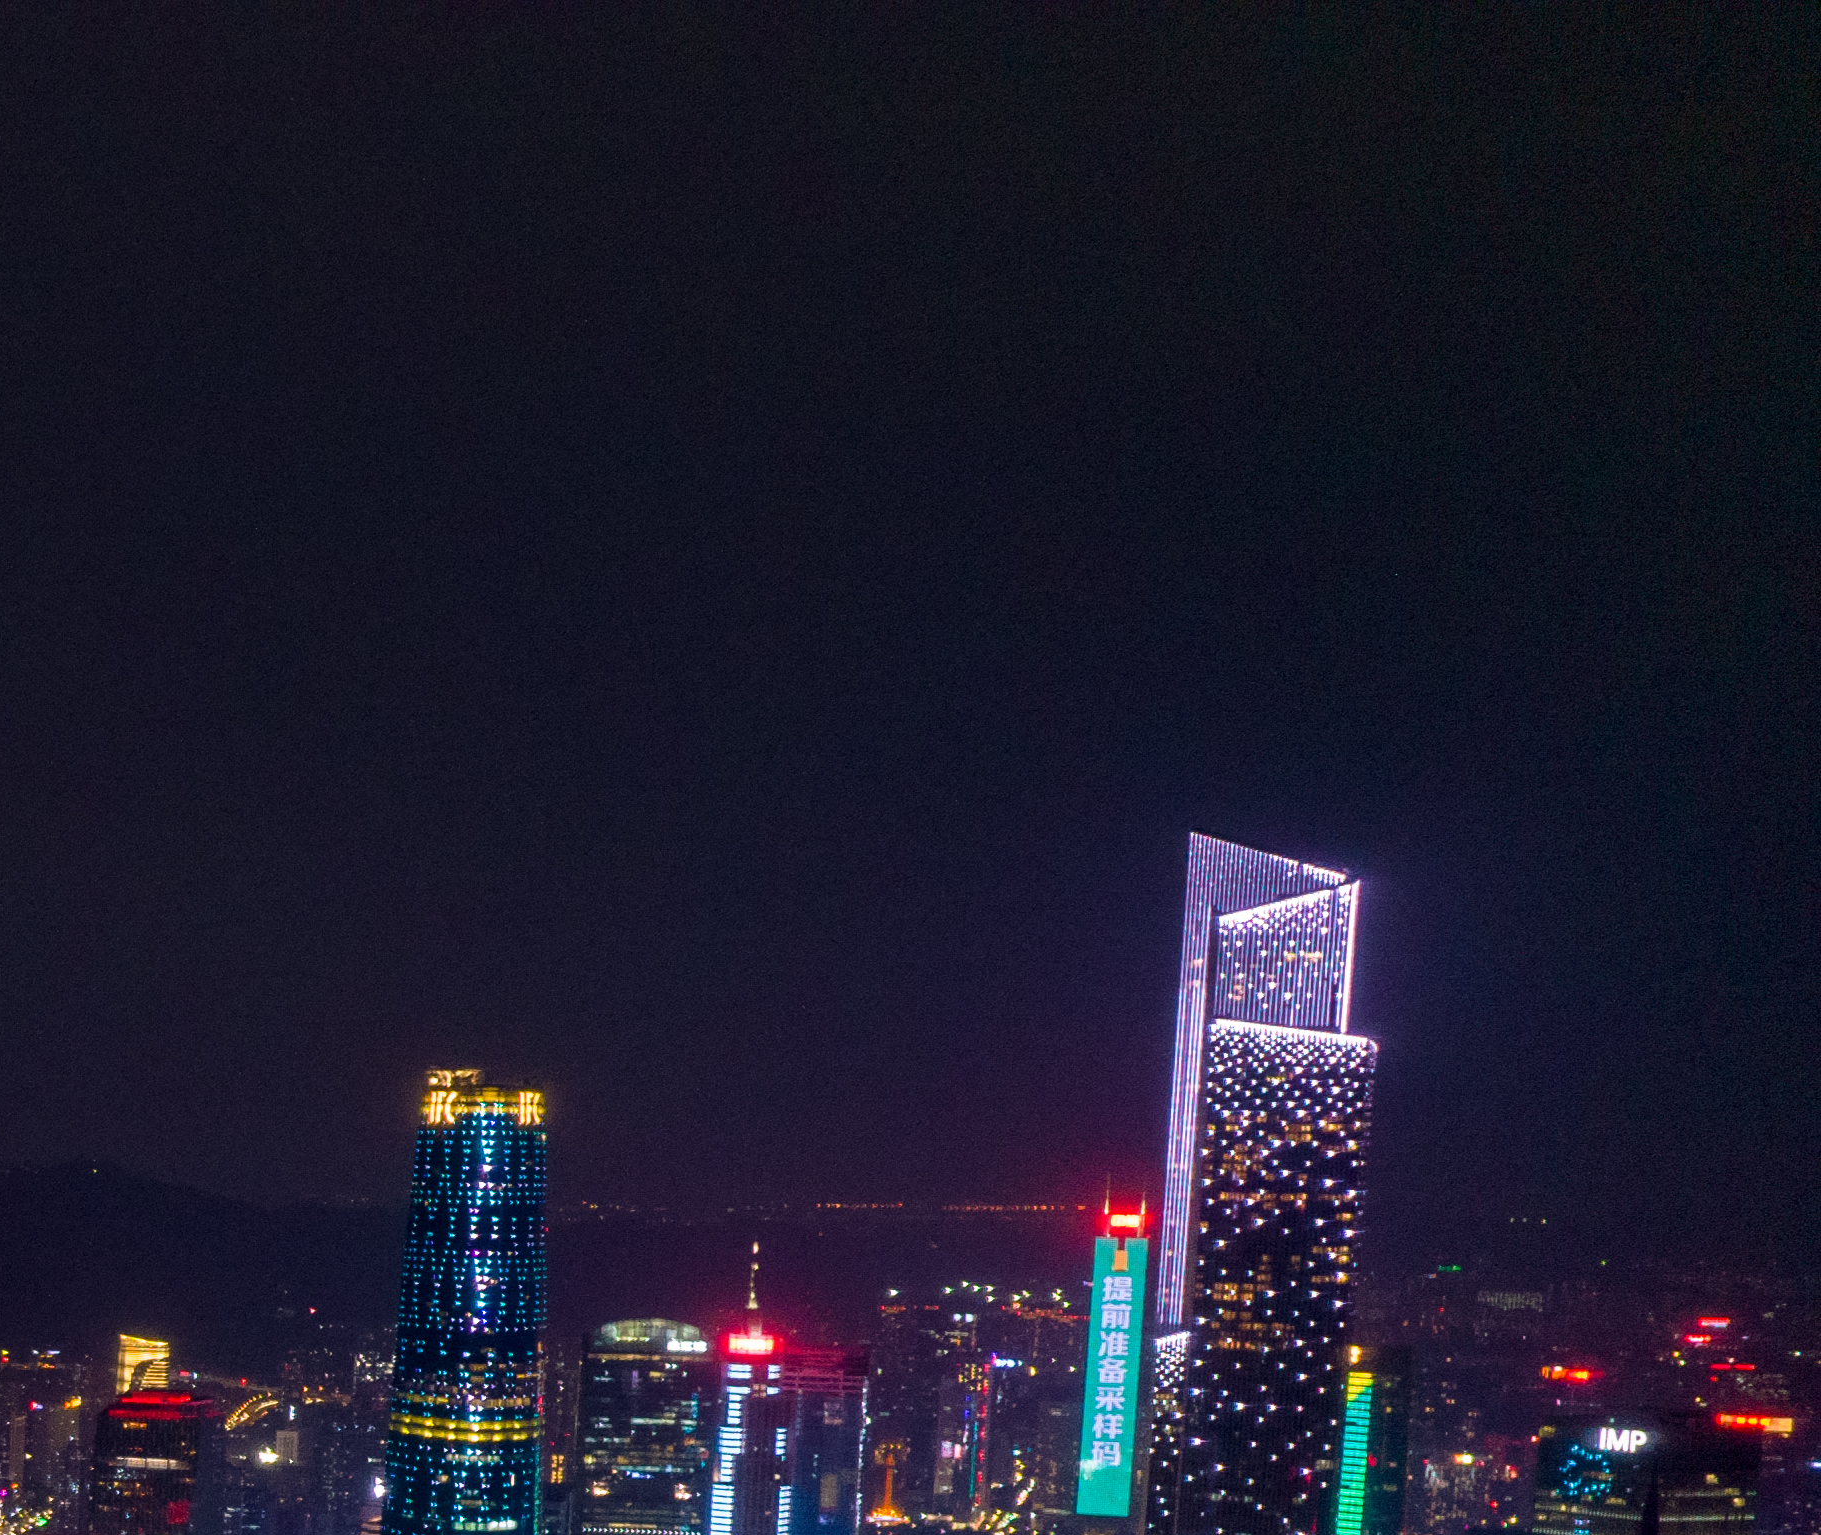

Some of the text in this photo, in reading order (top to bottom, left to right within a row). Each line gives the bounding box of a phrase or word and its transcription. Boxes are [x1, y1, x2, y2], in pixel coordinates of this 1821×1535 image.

[1091, 1275, 1133, 1467] 提前准备采样码
[1599, 1427, 1648, 1452] IMP
